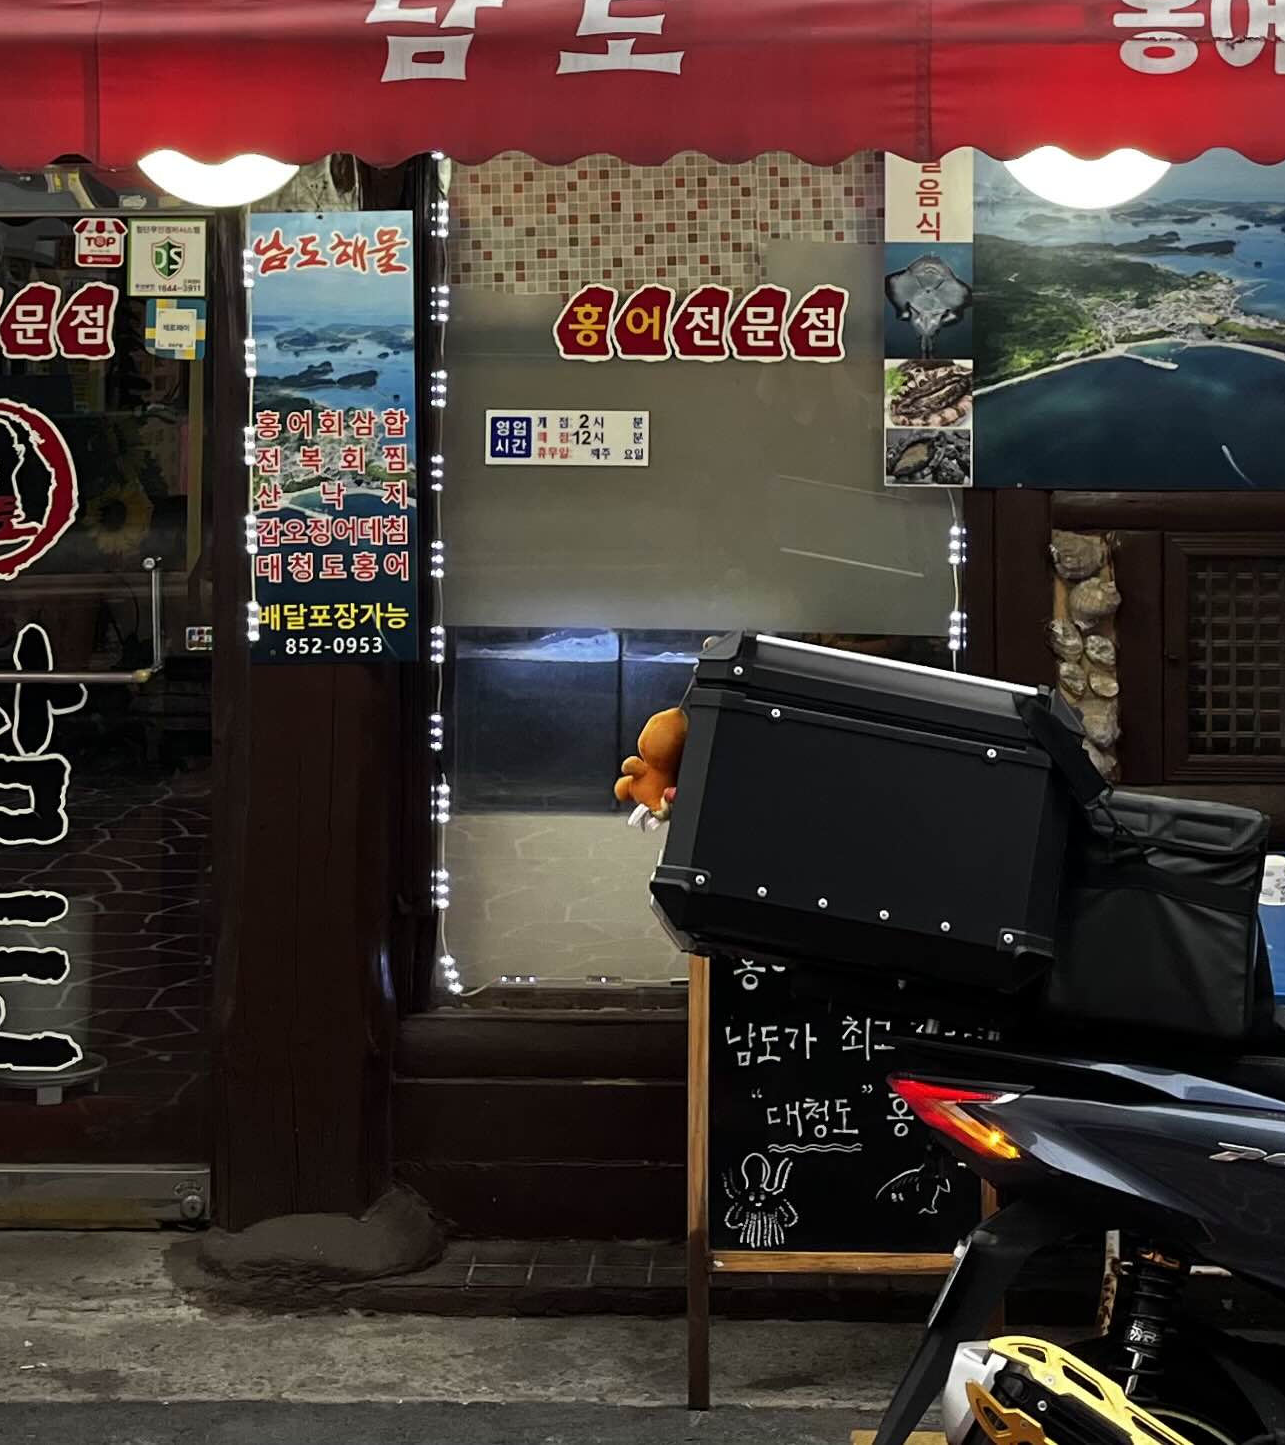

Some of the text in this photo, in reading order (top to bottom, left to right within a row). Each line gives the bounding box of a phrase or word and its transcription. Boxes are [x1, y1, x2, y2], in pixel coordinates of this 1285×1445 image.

[567, 302, 837, 348] 홍어전문점
[256, 409, 409, 439] 홍어회삼합
[496, 420, 527, 436] 영업
[496, 439, 527, 455] 시간
[256, 515, 409, 548] 갑오징어데침
[255, 551, 410, 584] 대청도홍어
[258, 602, 410, 632] 배달포장가능
[285, 636, 384, 655] 852-0953
[724, 1021, 817, 1066] 남도가
